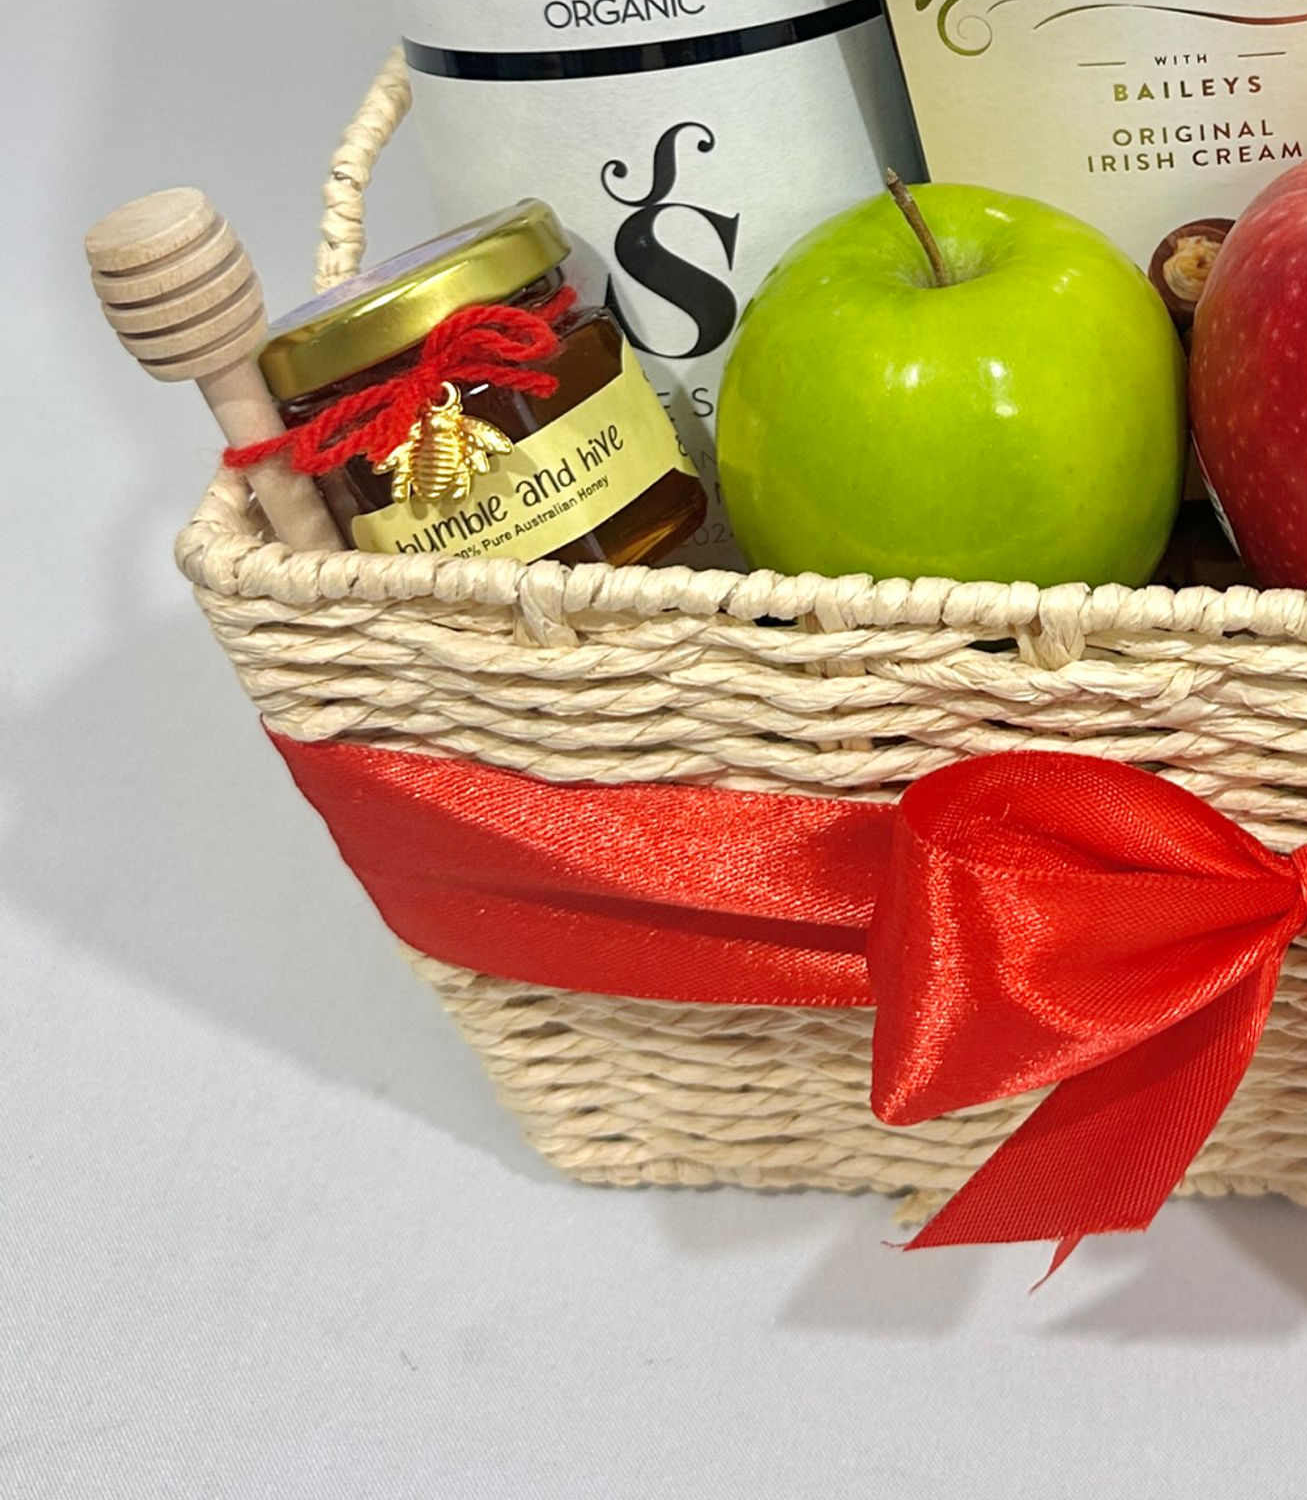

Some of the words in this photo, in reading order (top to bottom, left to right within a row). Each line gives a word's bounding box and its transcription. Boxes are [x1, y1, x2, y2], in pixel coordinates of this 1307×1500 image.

[1154, 53, 1209, 67] WITH
[1113, 75, 1264, 102] BAILEYS
[1112, 119, 1275, 147] ORIGINAL
[1087, 151, 1175, 173] IRISH
[1191, 141, 1304, 168] CREAM
[516, 458, 576, 507] and
[577, 424, 624, 472] hive
[483, 529, 513, 552] Pure
[515, 495, 578, 536] Australian
[578, 475, 610, 502] Honey
